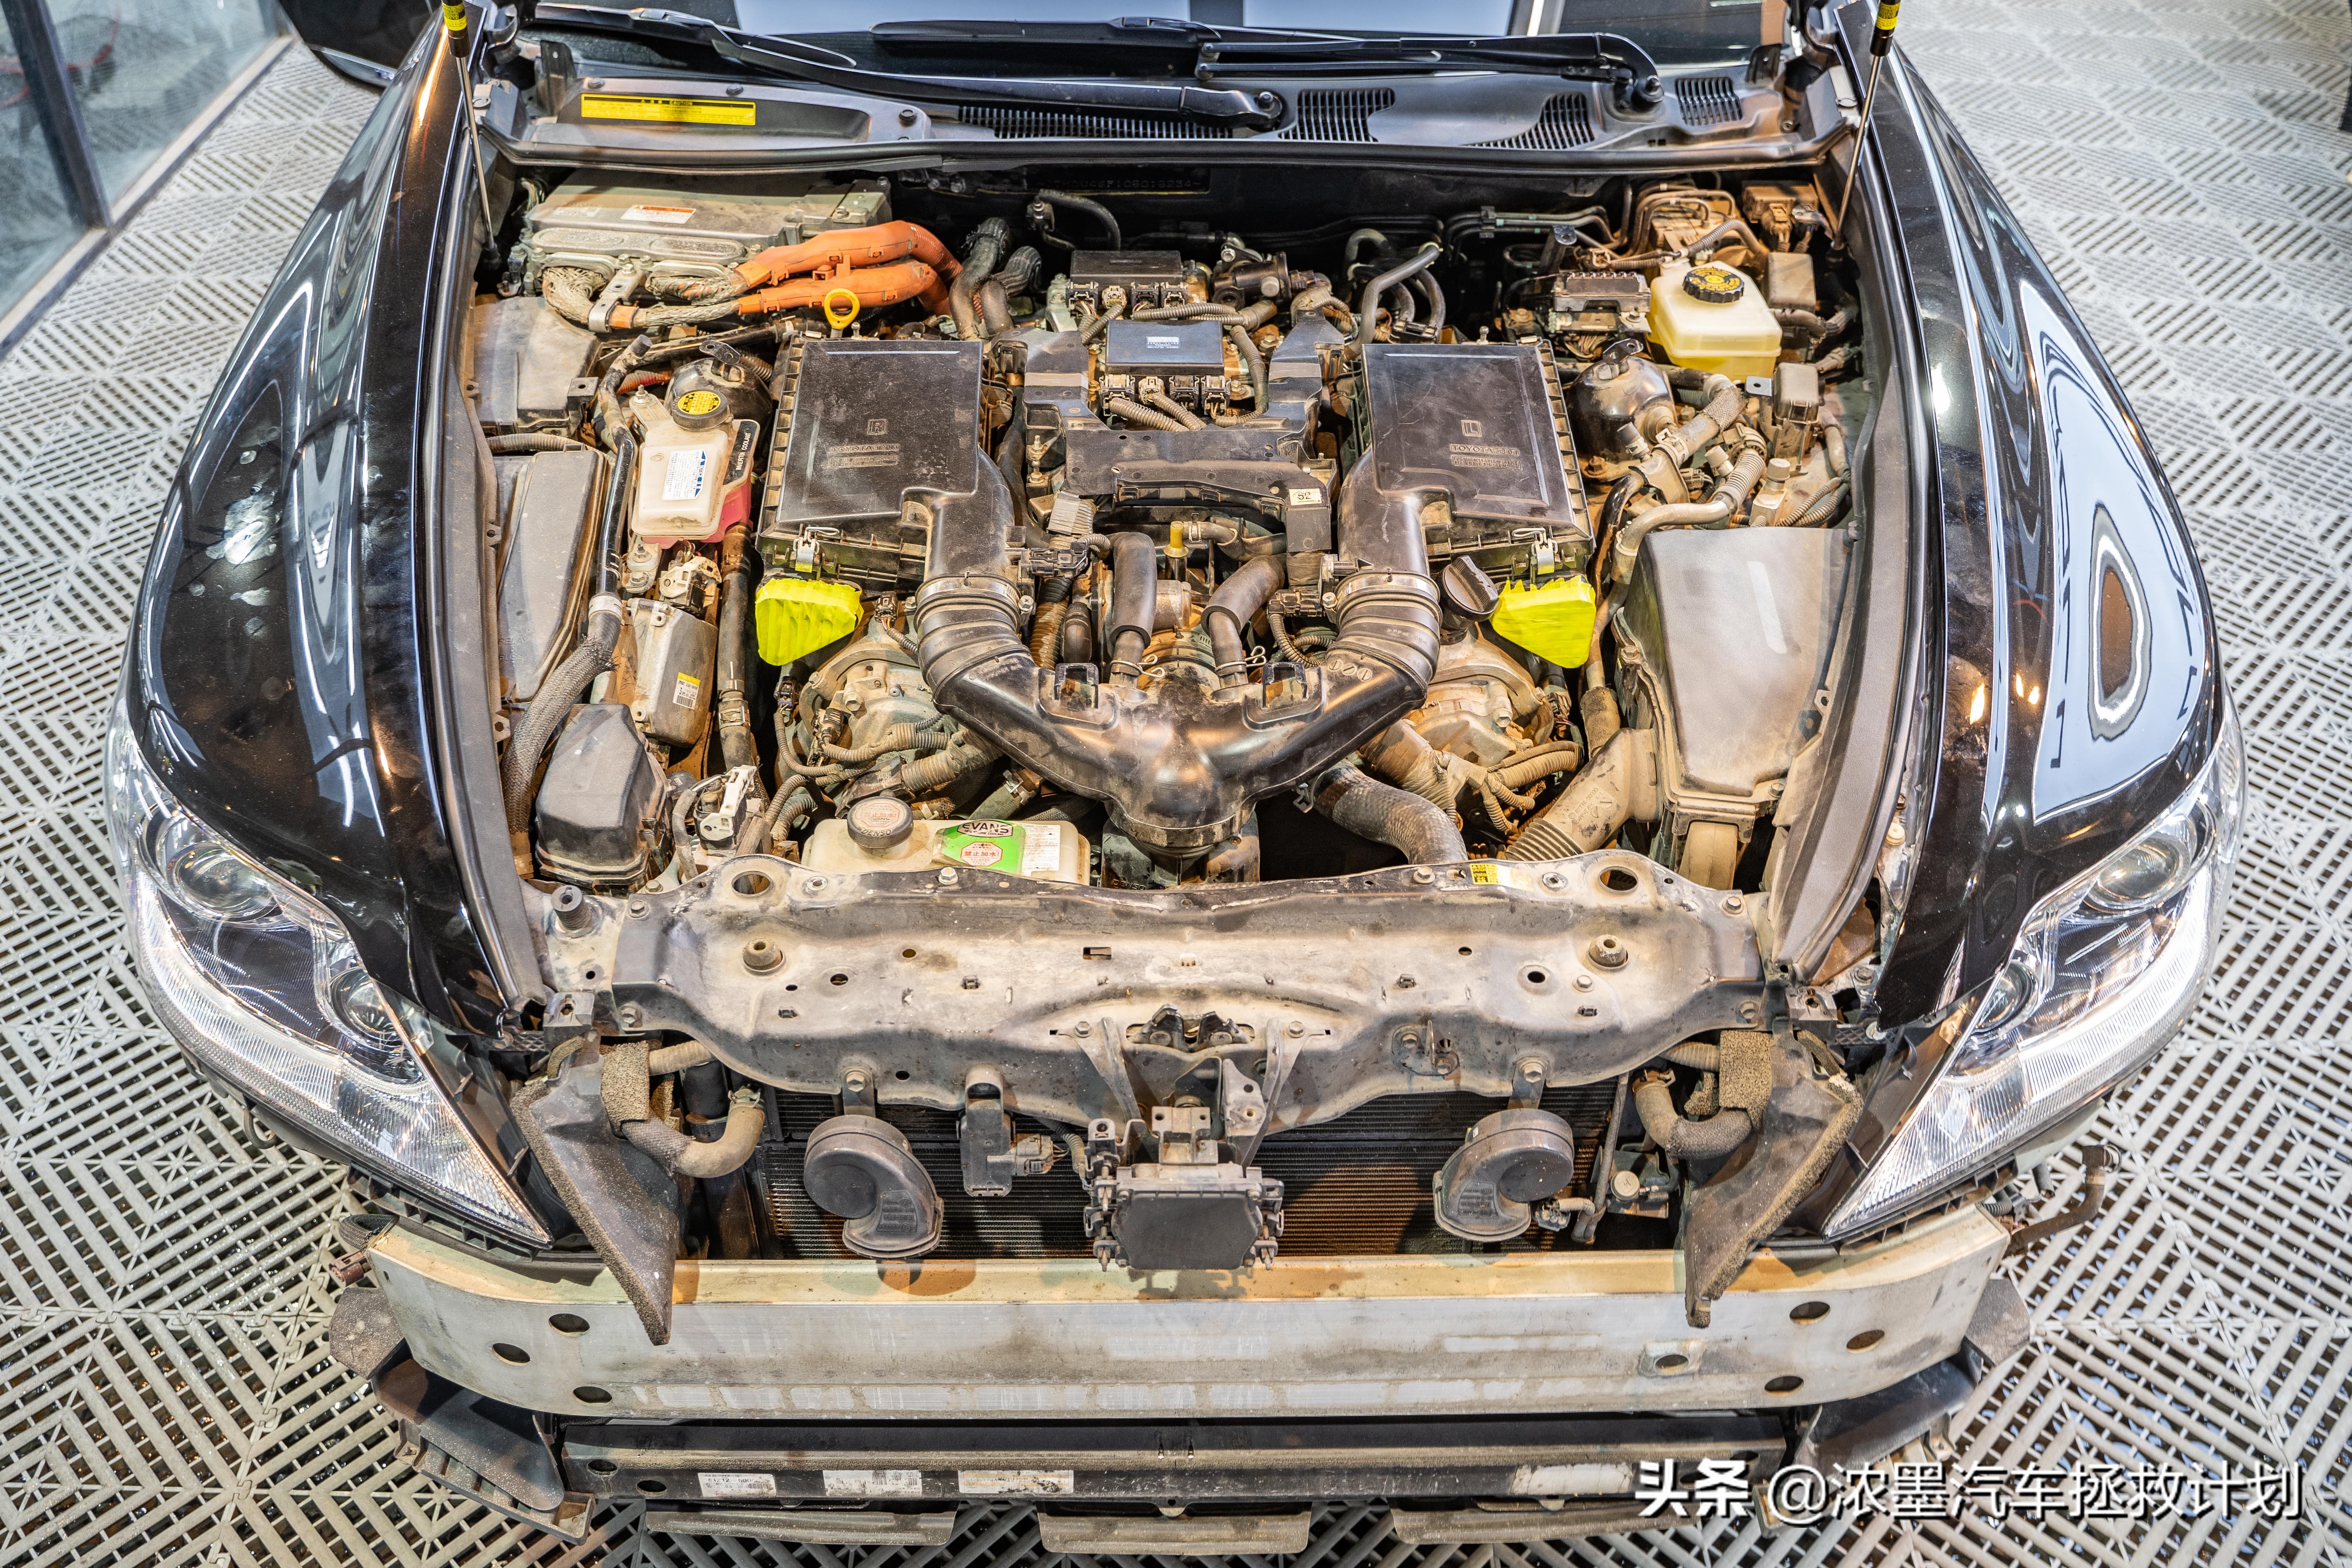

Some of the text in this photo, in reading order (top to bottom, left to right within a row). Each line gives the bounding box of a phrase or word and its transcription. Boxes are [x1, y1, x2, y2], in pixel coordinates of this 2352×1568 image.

[741, 433, 751, 450] COOLANT
[1452, 445, 1493, 453] TOYOTA
[735, 451, 746, 470] INVERTER
[962, 823, 1009, 833] EVANS
